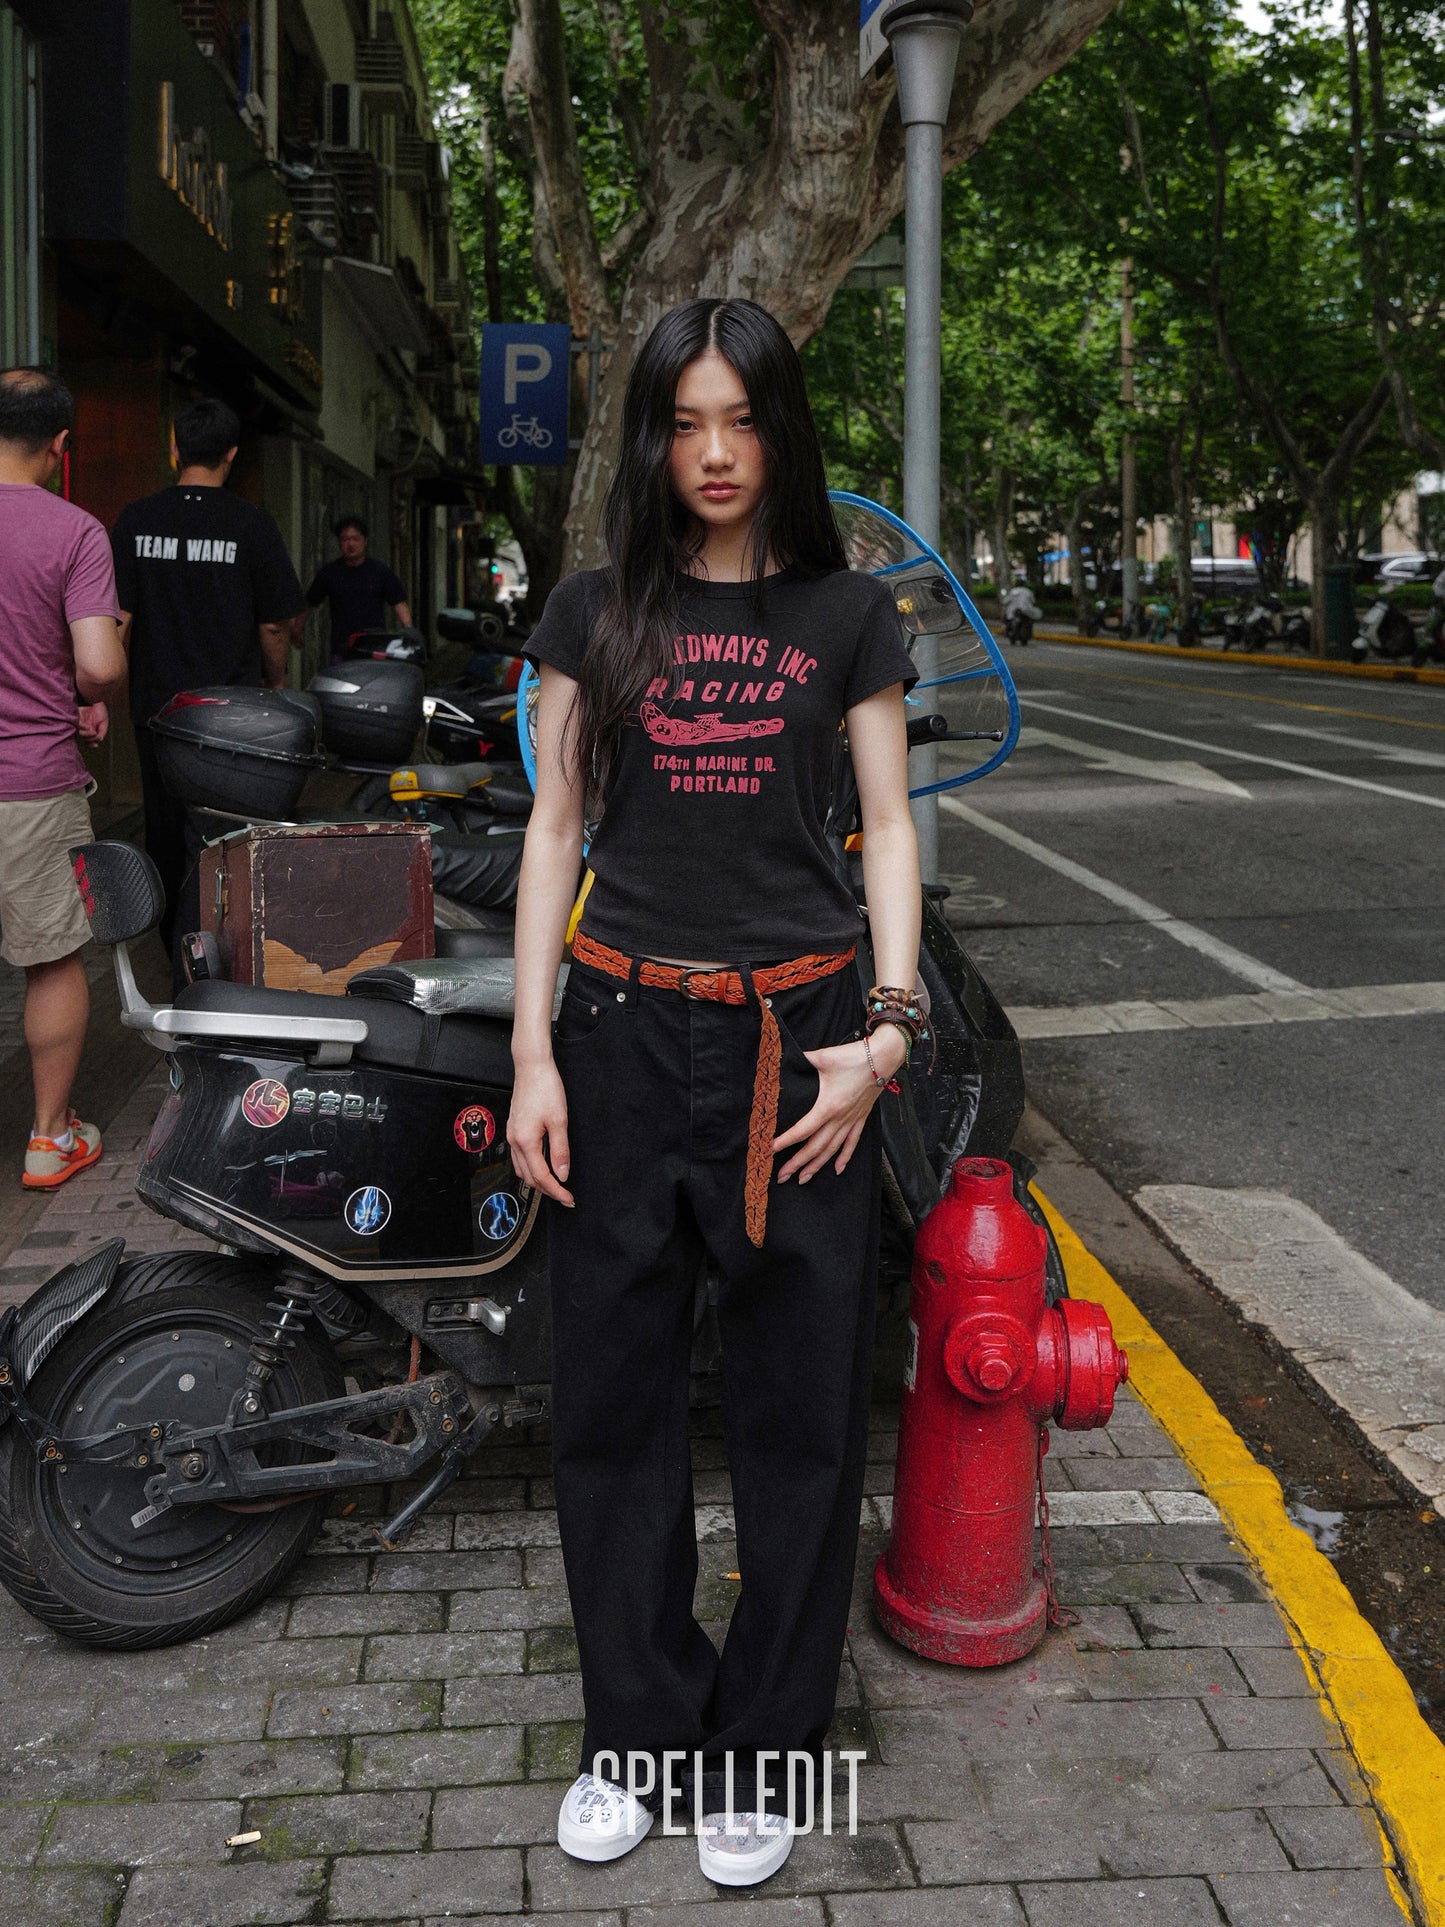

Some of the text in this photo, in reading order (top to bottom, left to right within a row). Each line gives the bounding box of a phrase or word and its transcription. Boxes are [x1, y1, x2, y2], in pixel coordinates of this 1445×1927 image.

[504, 343, 553, 405] P
[134, 535, 238, 565] TEAM WANG
[776, 645, 818, 685] INC
[645, 677, 787, 704] RACING
[695, 755, 748, 772] MARINE
[754, 756, 777, 773] DR.
[670, 775, 762, 795] PORTLAND
[292, 1087, 389, 1124] 宝宝巴士
